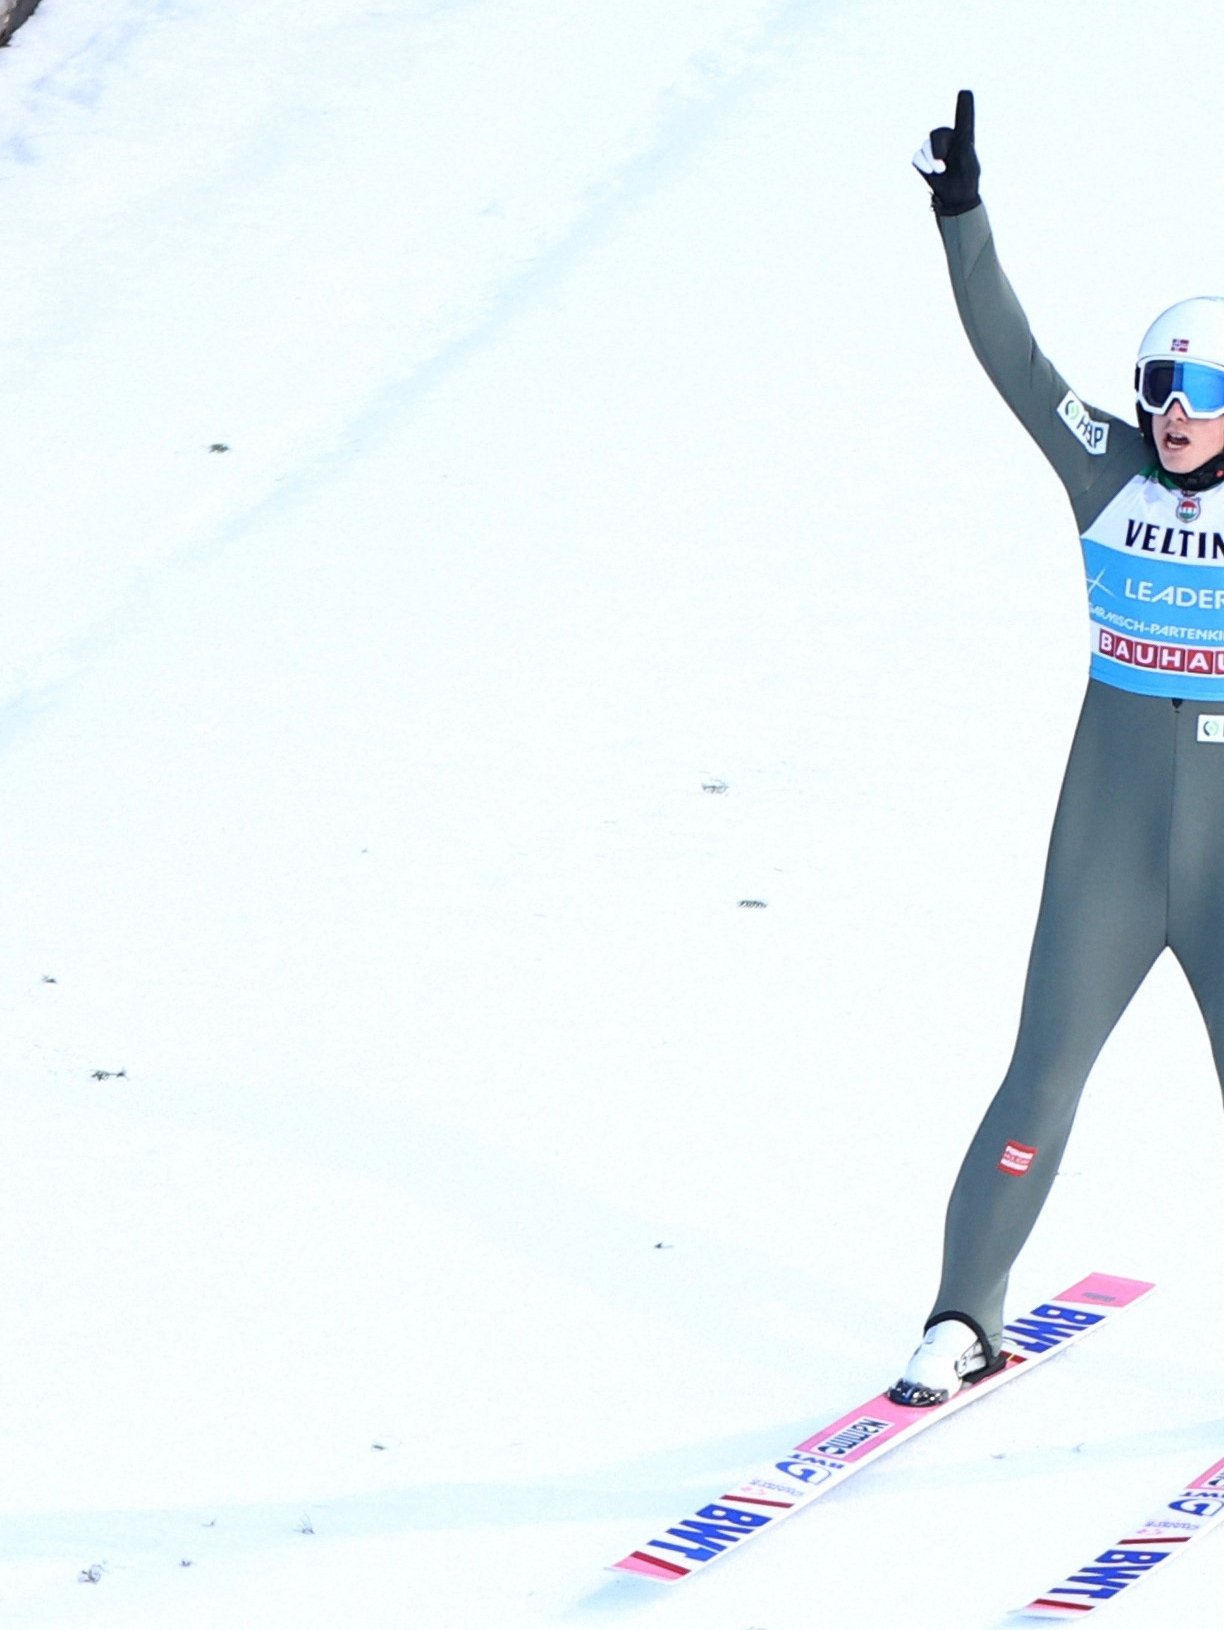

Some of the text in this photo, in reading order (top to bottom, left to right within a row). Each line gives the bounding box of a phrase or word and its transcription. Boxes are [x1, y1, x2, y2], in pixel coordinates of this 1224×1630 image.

[1001, 1303, 1107, 1354] BWT
[646, 1503, 774, 1562] BWT
[1046, 1549, 1172, 1600] BWT
